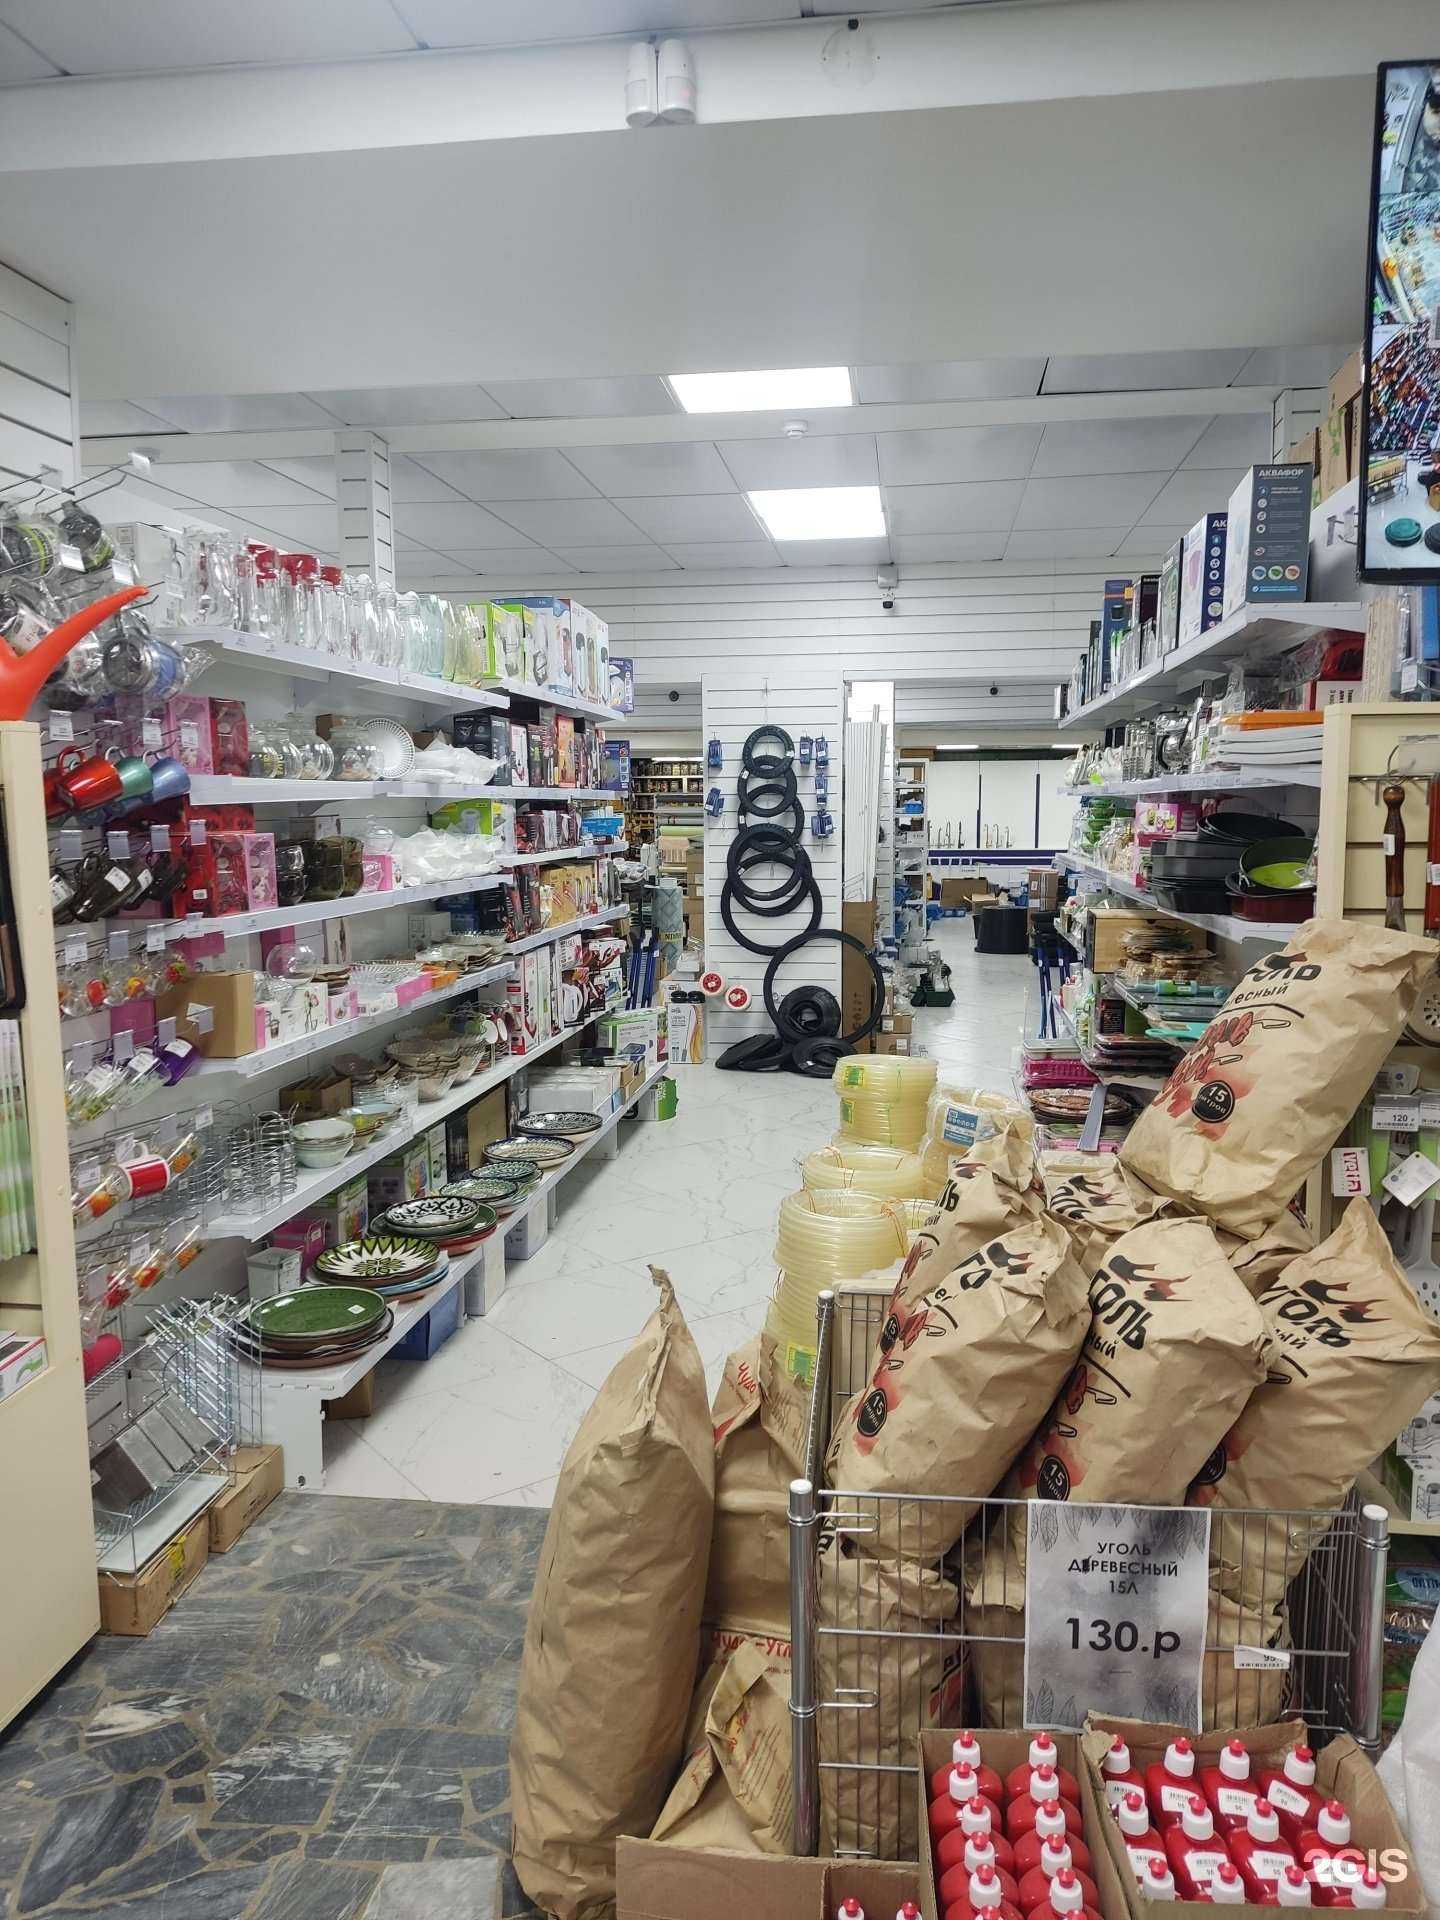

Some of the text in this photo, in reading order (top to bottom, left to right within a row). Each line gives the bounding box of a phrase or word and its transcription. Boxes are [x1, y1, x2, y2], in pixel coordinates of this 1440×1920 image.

[1258, 468, 1304, 477] АКВАФОР
[1211, 519, 1228, 528] АК
[1228, 981, 1289, 1005] есный
[1208, 1085, 1229, 1102] 15
[1392, 1113, 1408, 1123] 120
[1086, 1268, 1155, 1351] ГОЛЬ
[1258, 1285, 1351, 1348] ГОЛЬ
[872, 1395, 885, 1416] 15
[1049, 1463, 1066, 1487] 15
[1096, 1541, 1151, 1556] УГОЛЬ
[1109, 1580, 1139, 1595] 15Л
[1065, 1617, 1182, 1660] 130.р
